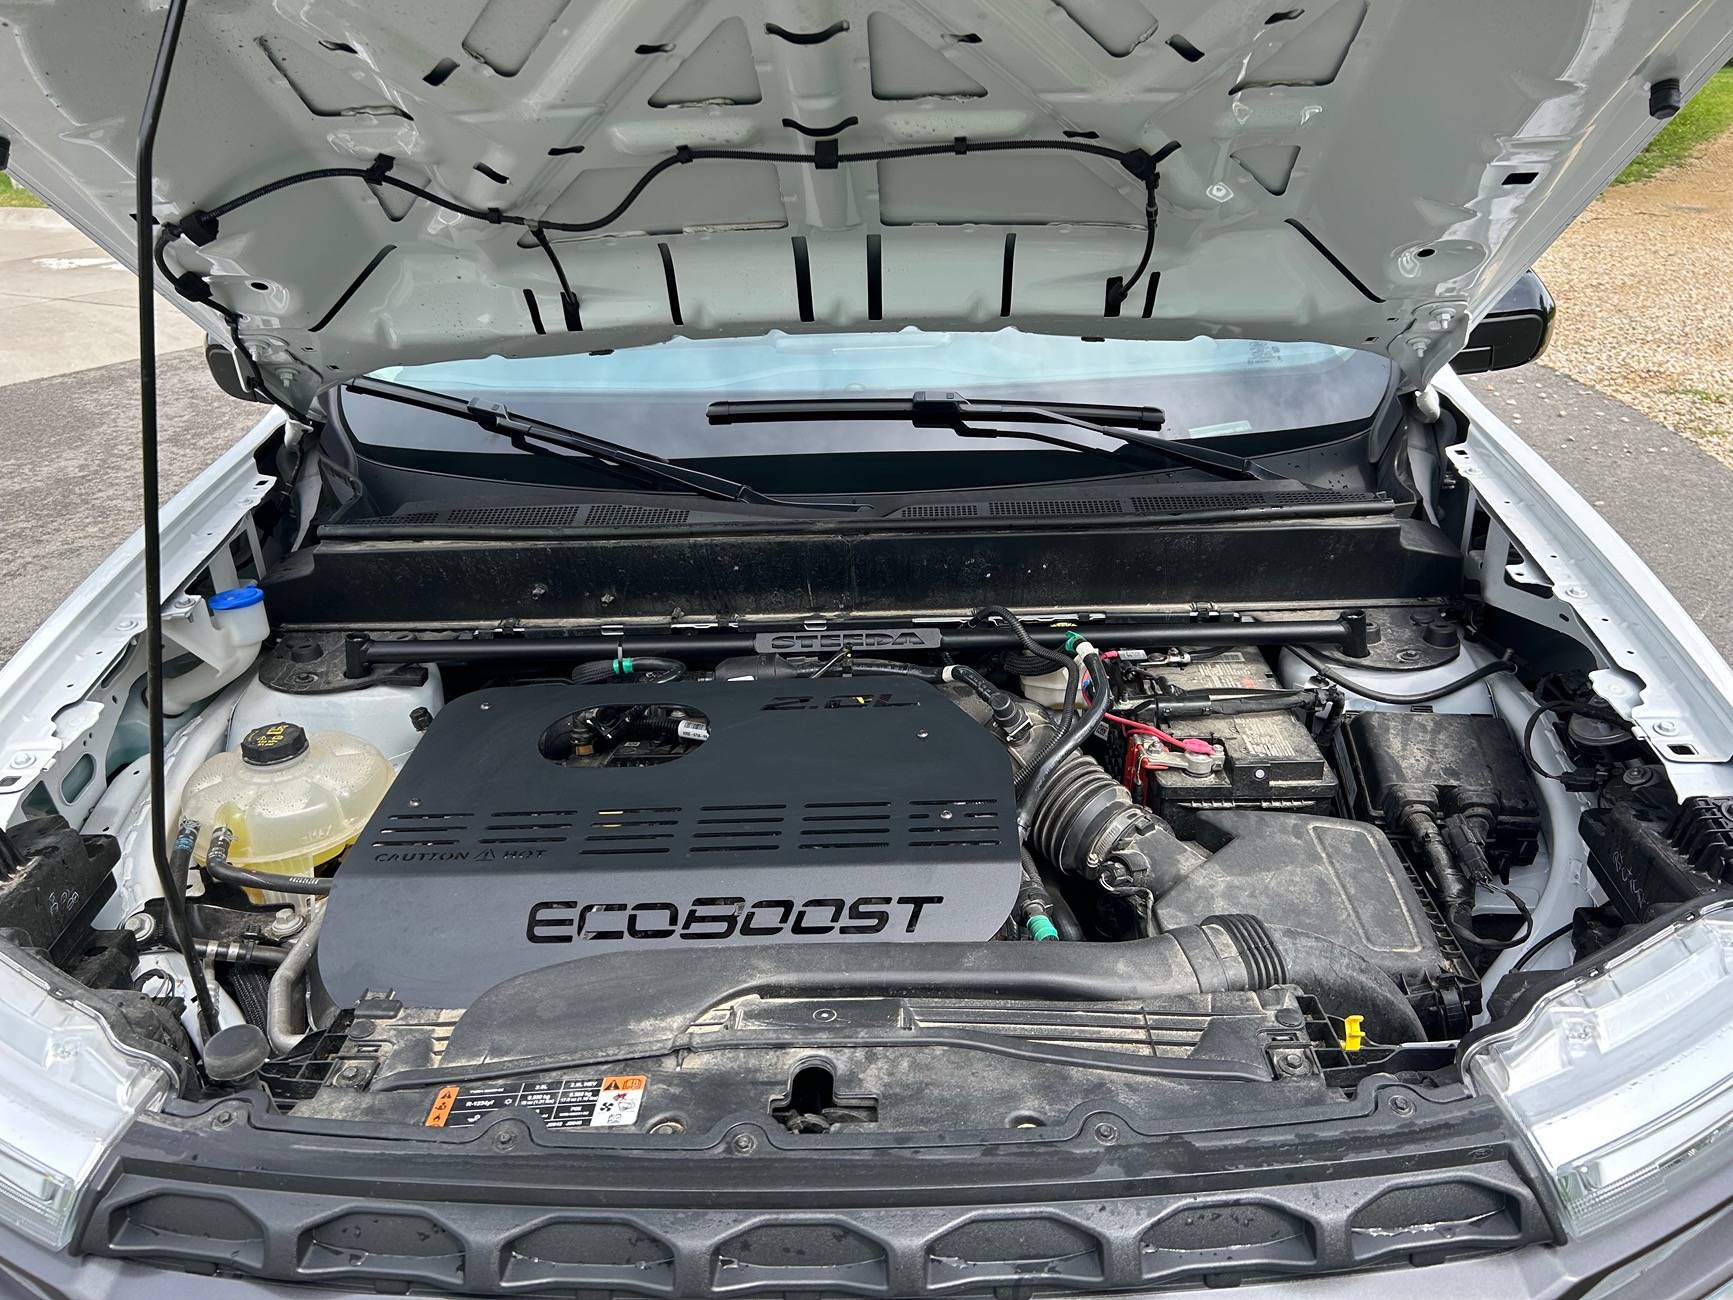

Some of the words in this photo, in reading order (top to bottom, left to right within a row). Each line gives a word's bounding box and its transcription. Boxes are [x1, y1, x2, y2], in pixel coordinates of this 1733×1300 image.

[771, 632, 925, 649] STEEDA
[760, 694, 920, 710] 2.0L
[374, 852, 470, 862] CAUTION
[503, 850, 546, 859] HOT
[526, 896, 945, 944] ECOBOOST
